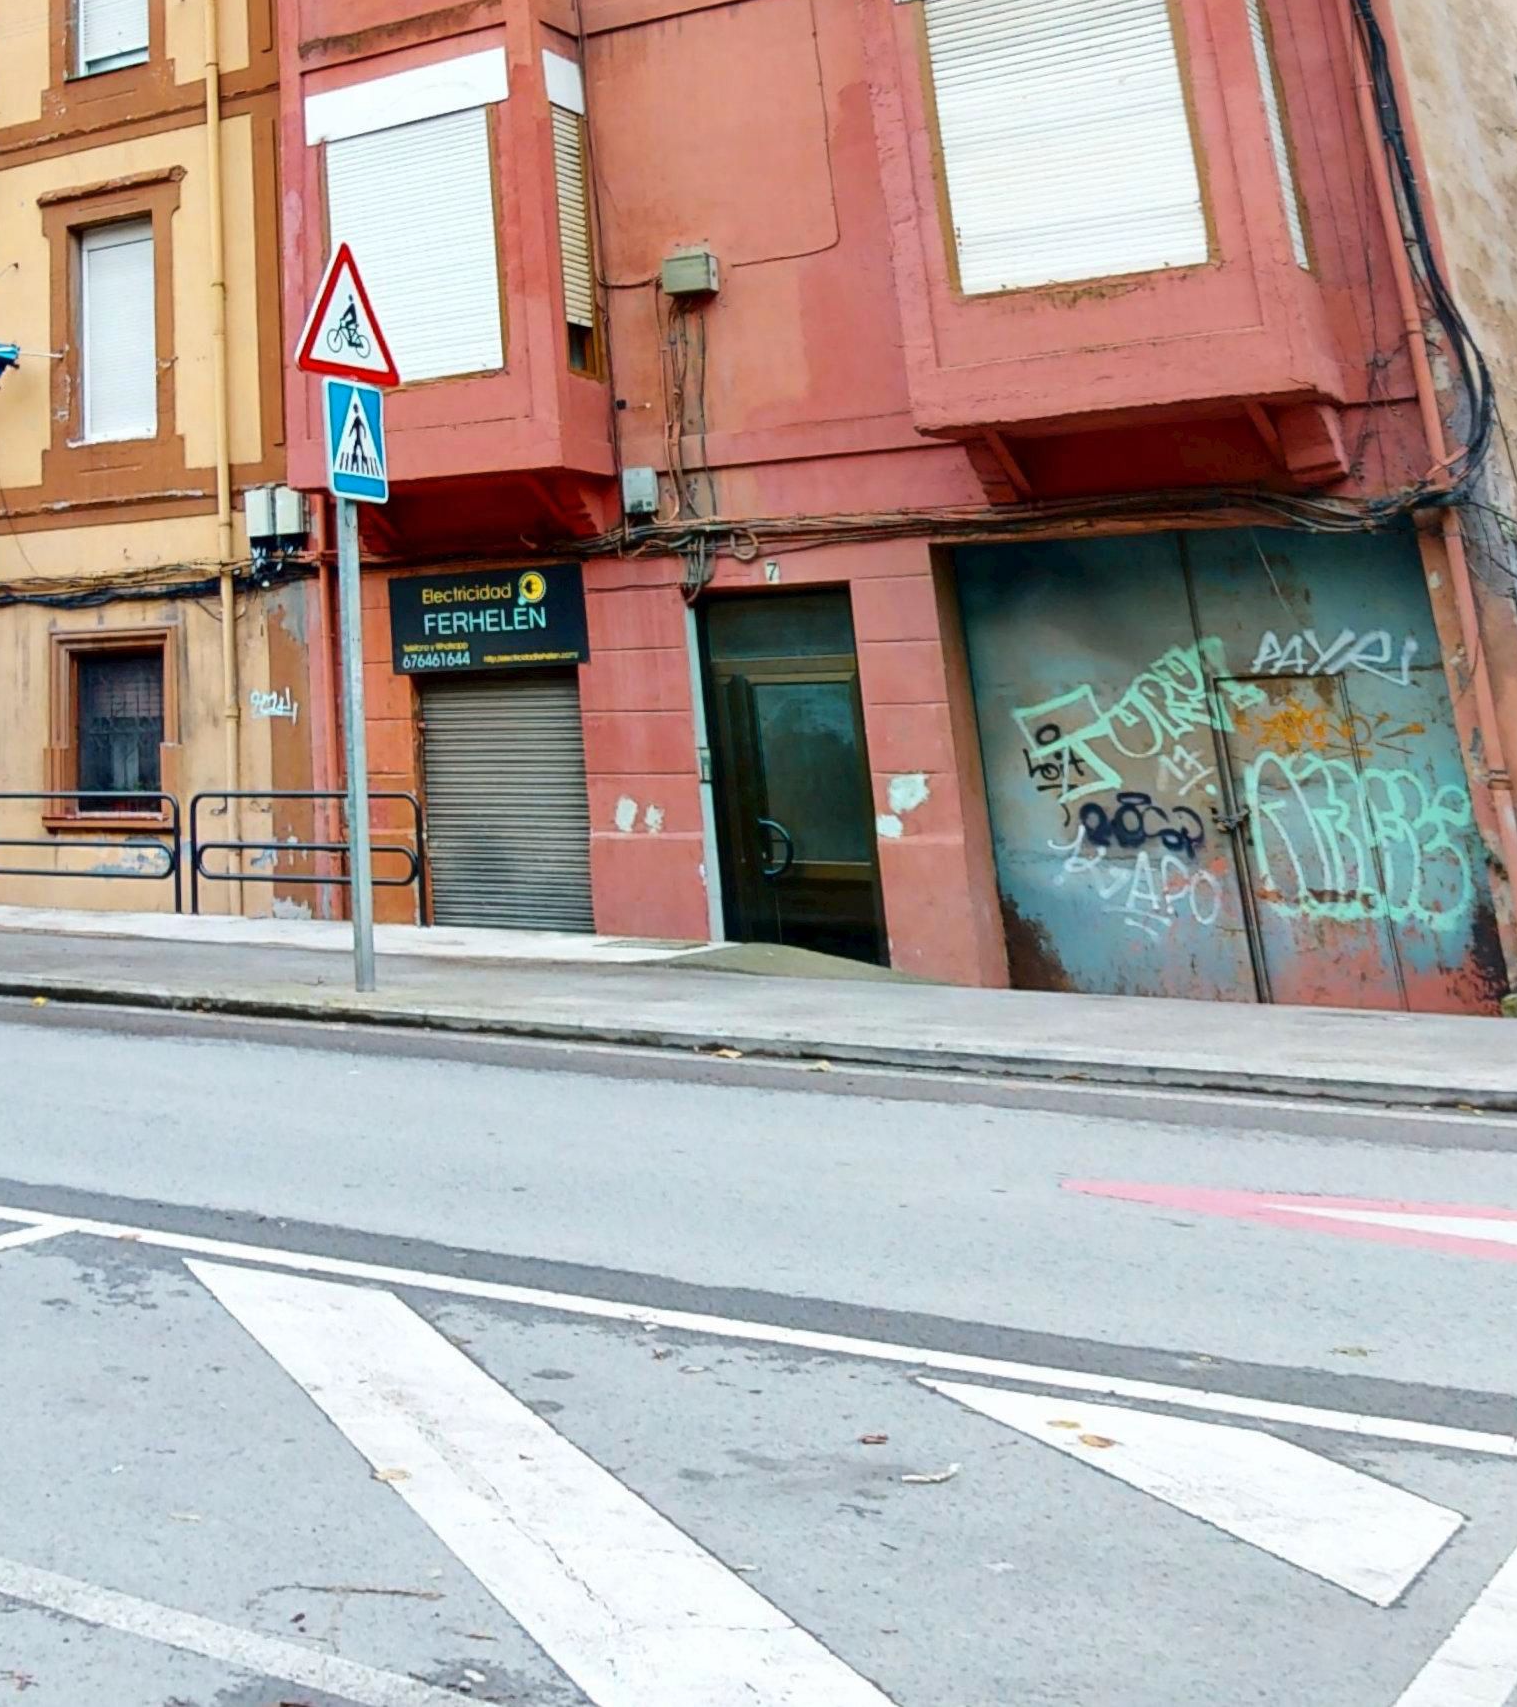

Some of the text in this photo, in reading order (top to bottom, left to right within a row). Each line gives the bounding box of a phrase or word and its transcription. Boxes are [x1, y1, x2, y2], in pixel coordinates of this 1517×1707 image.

[766, 562, 777, 582] 7
[422, 583, 511, 605] Electricidad
[424, 607, 547, 635] FERHELEN
[403, 651, 470, 669] 676461644
